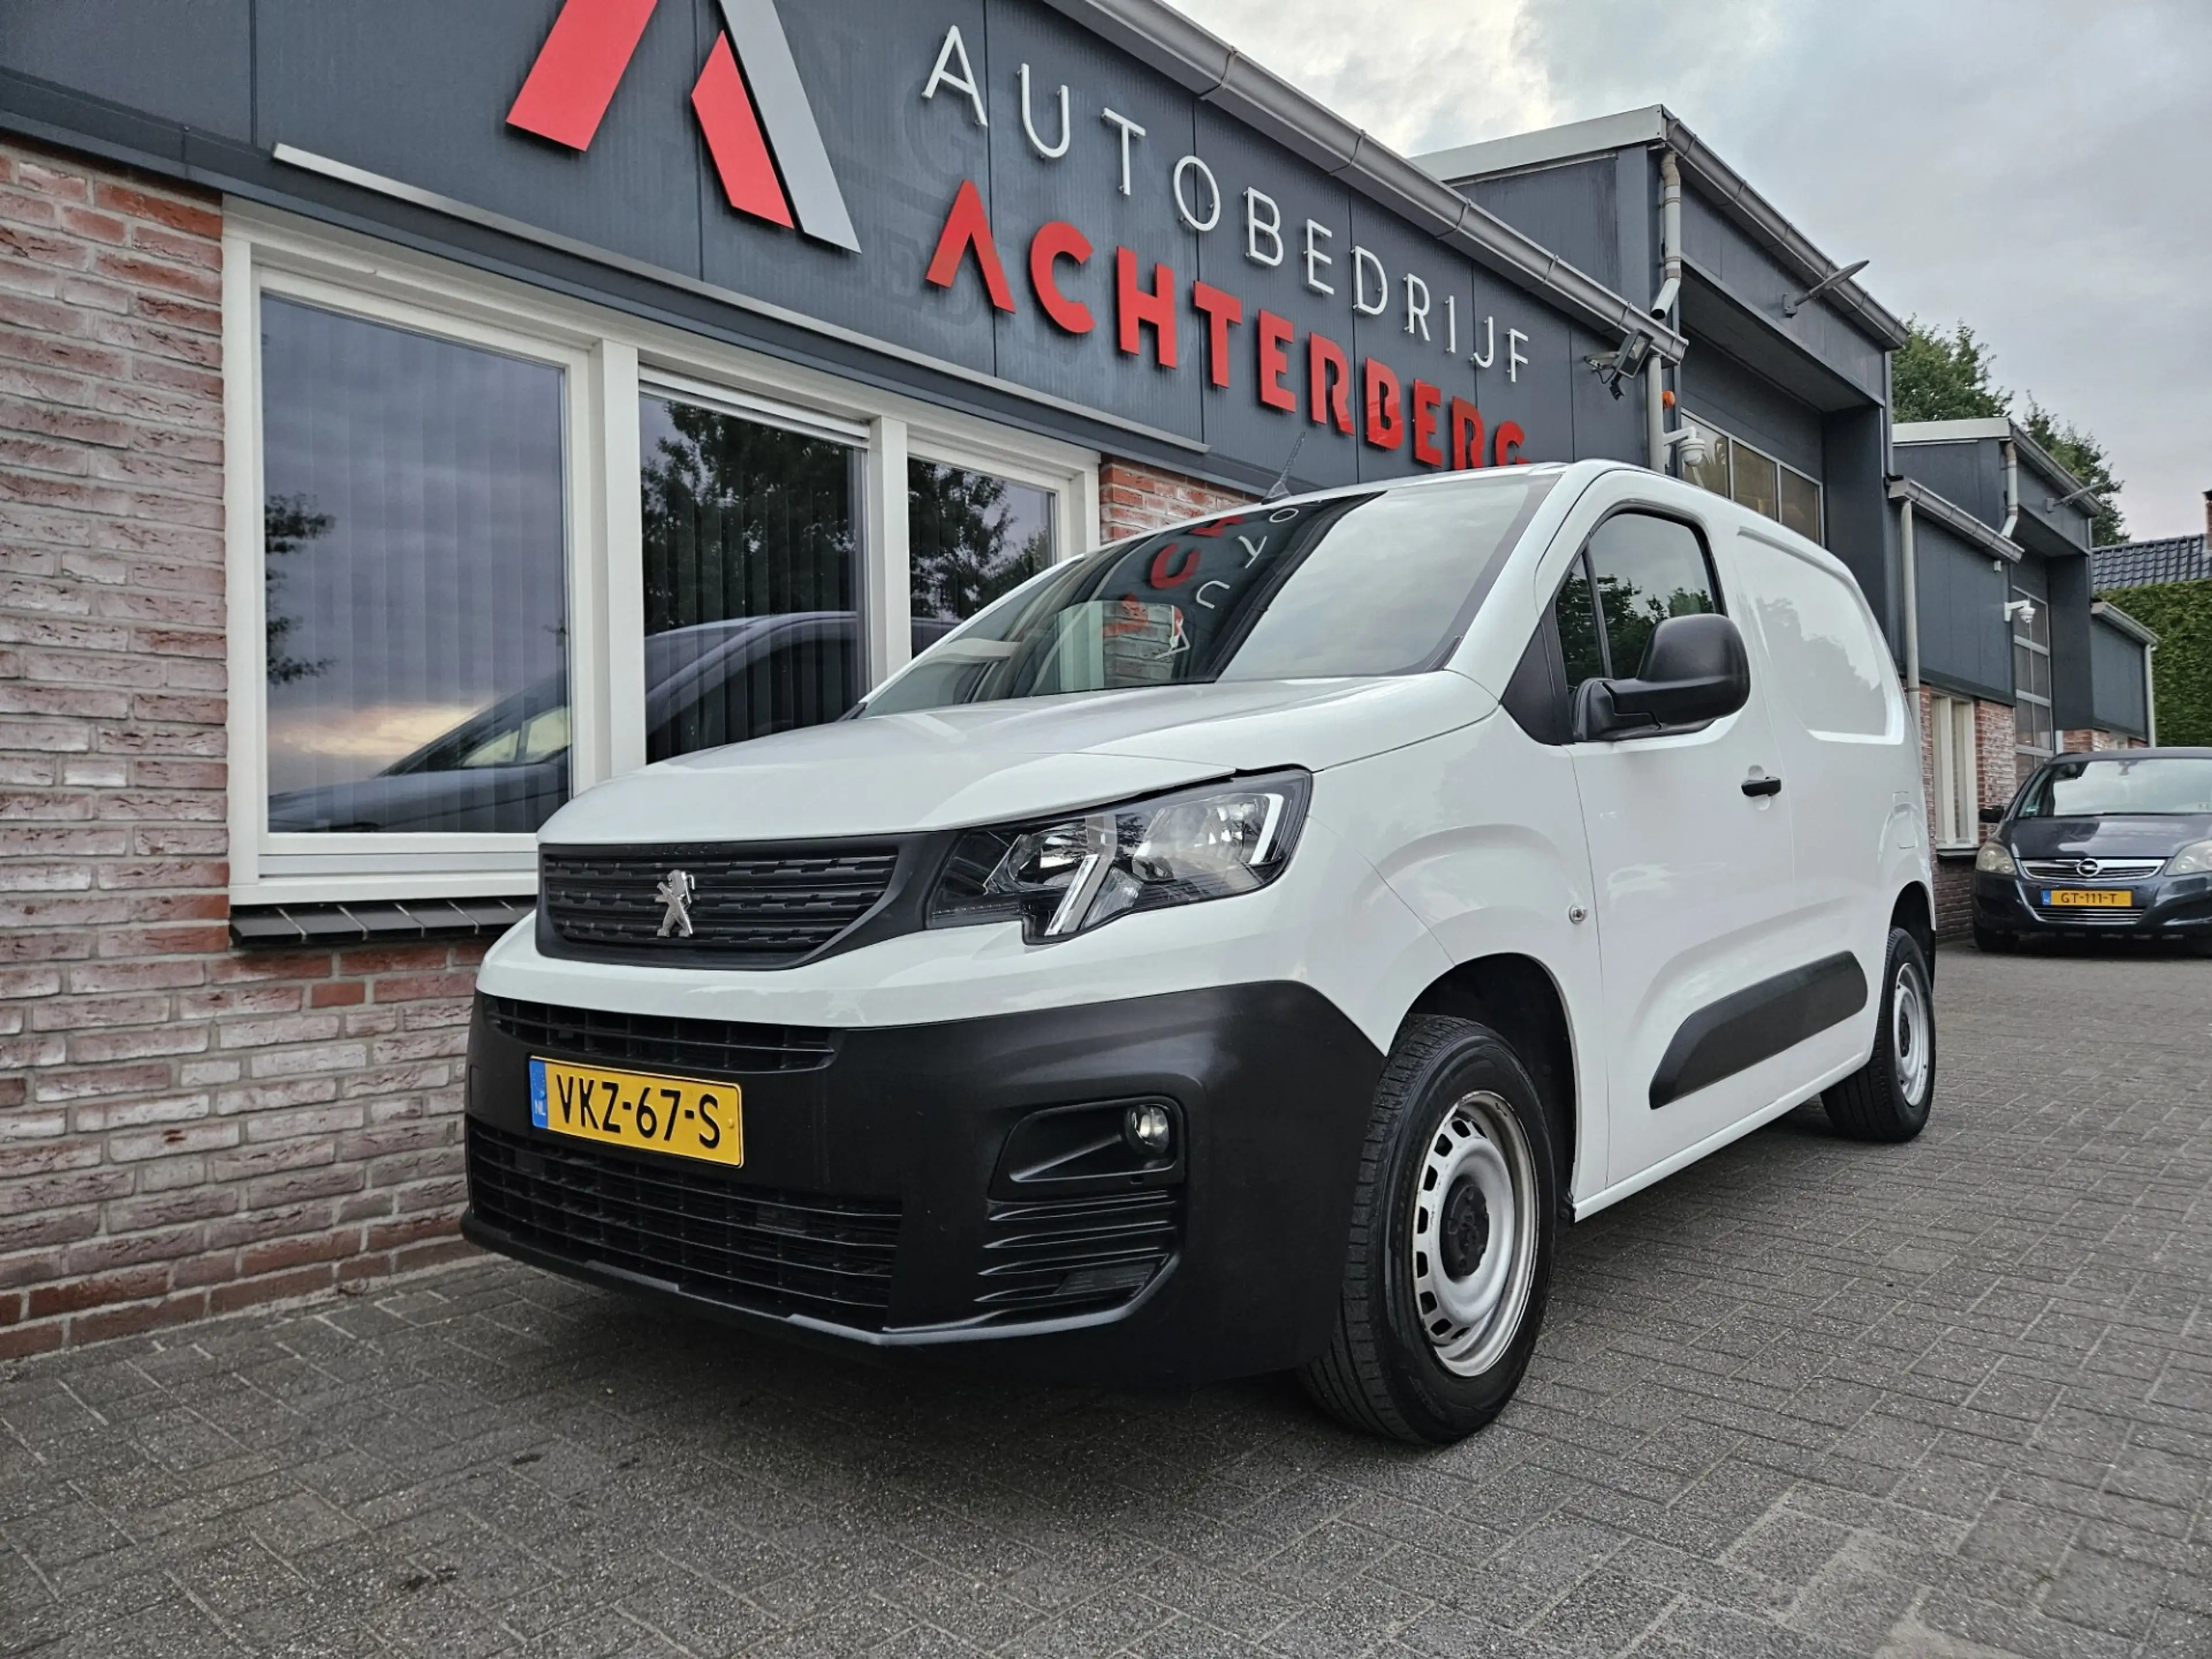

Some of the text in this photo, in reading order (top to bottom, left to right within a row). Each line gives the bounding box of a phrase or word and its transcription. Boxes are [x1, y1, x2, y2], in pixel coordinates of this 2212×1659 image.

[921, 25, 1529, 382] AUTOBEDRIJF
[926, 180, 1531, 470] ACHTERBERG
[2061, 892, 2118, 904] GT-111-T
[556, 1074, 721, 1149] VKZ-67-S
